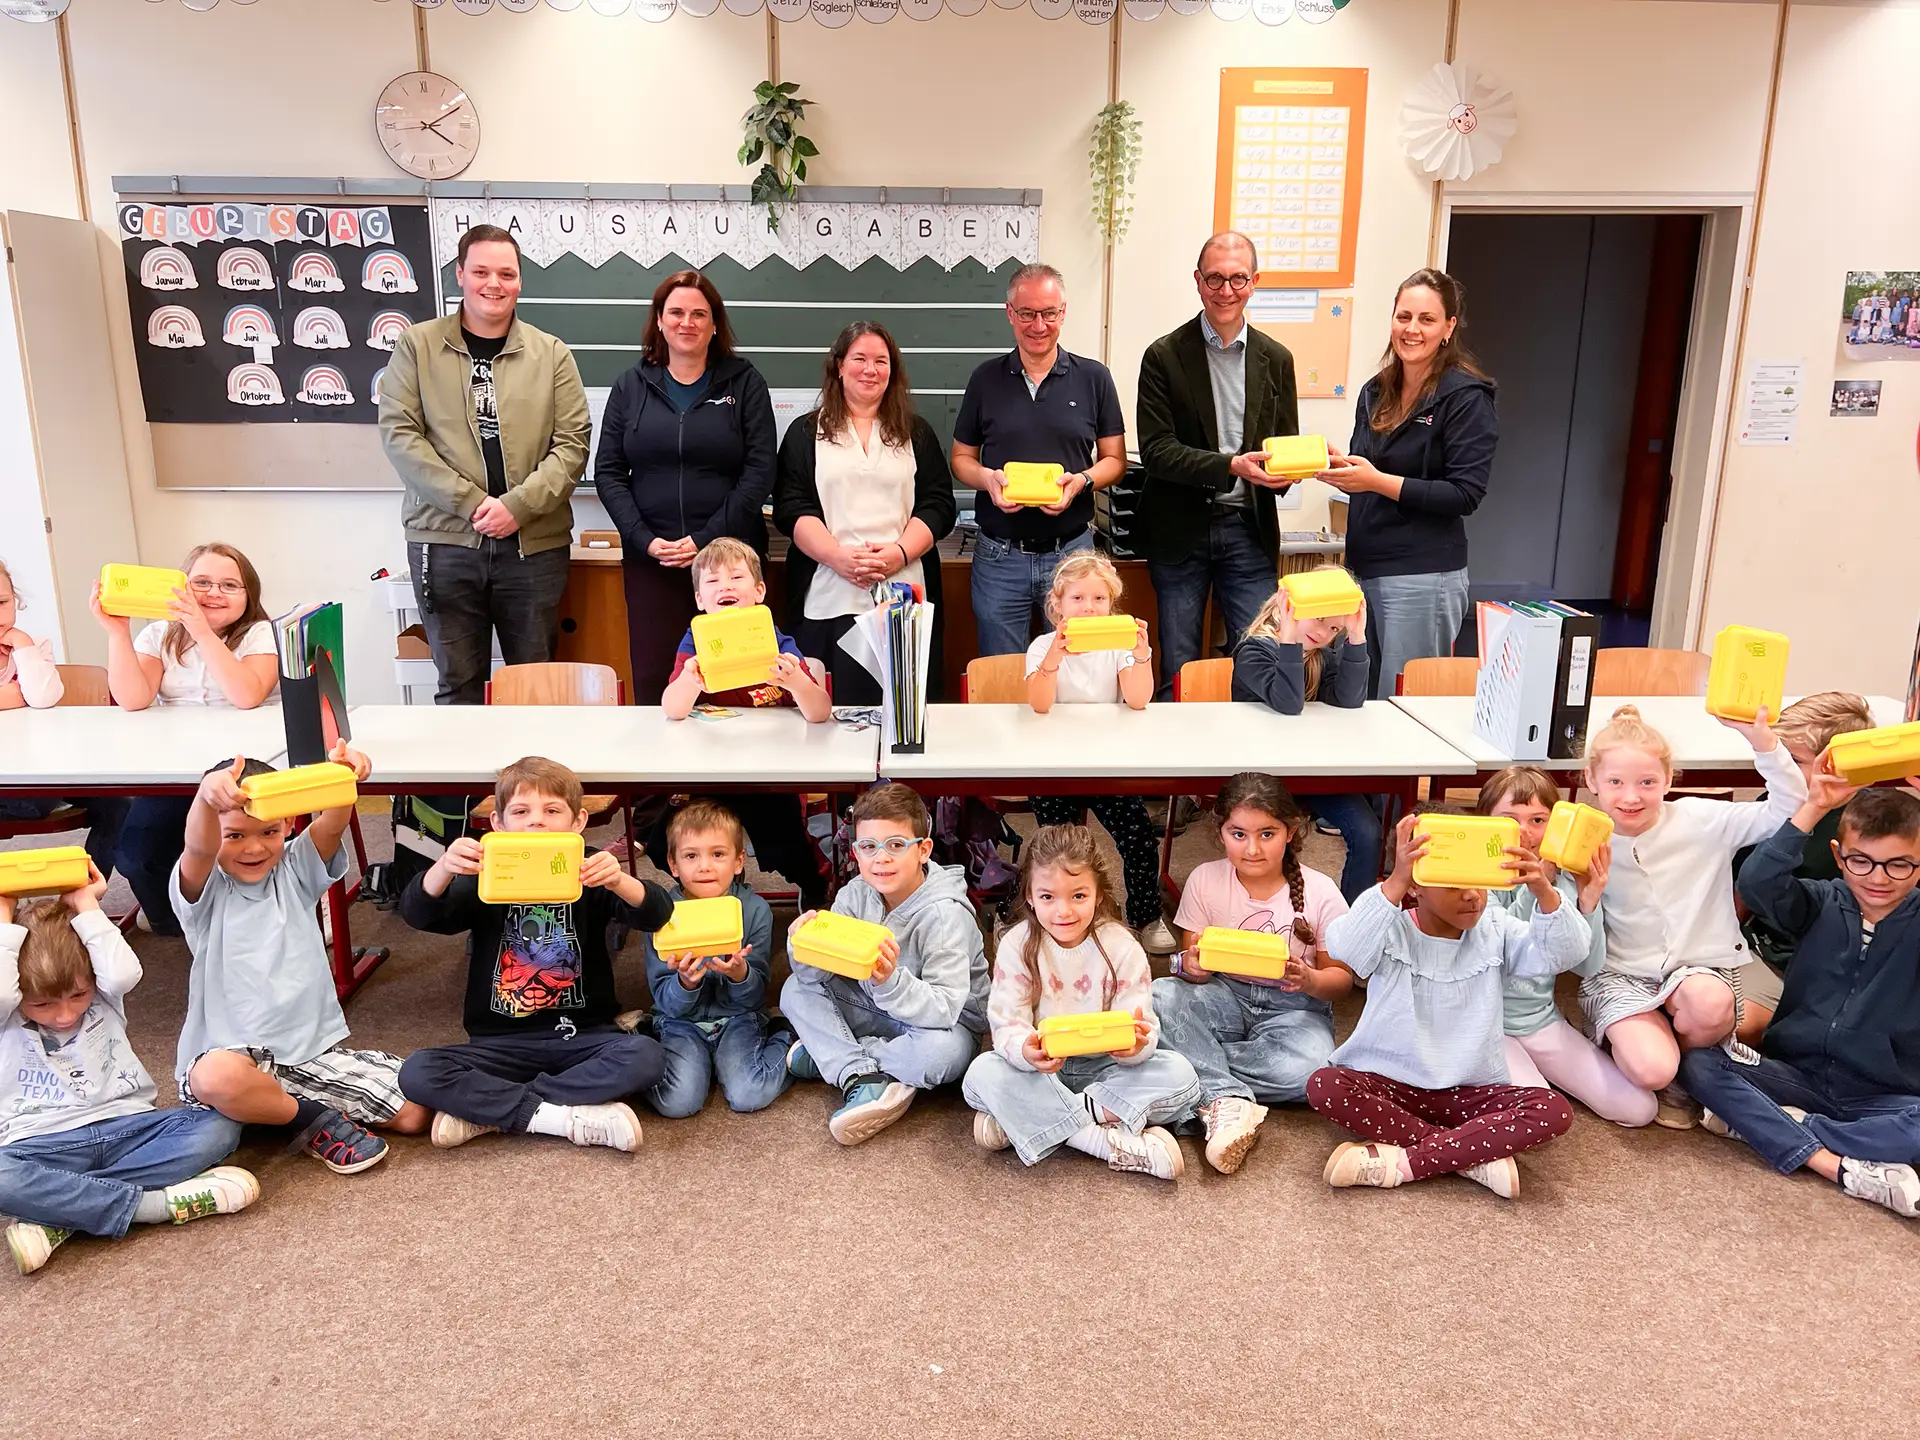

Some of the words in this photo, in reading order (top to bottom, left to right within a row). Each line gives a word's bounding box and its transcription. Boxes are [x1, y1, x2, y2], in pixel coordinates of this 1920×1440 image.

[812, 1, 853, 14] Sogleich
[124, 204, 390, 238] GEBURTSTAG
[155, 275, 184, 286] Januar
[231, 276, 261, 286] Februar
[381, 278, 399, 291] April
[168, 333, 185, 344] Mai
[243, 332, 260, 343] Juni
[314, 334, 328, 345] Juli
[240, 391, 271, 402] Oktober
[306, 390, 348, 402] November
[1486, 842, 1504, 858] BOX
[550, 860, 569, 876] BOX
[21, 1084, 65, 1102] TEAM
